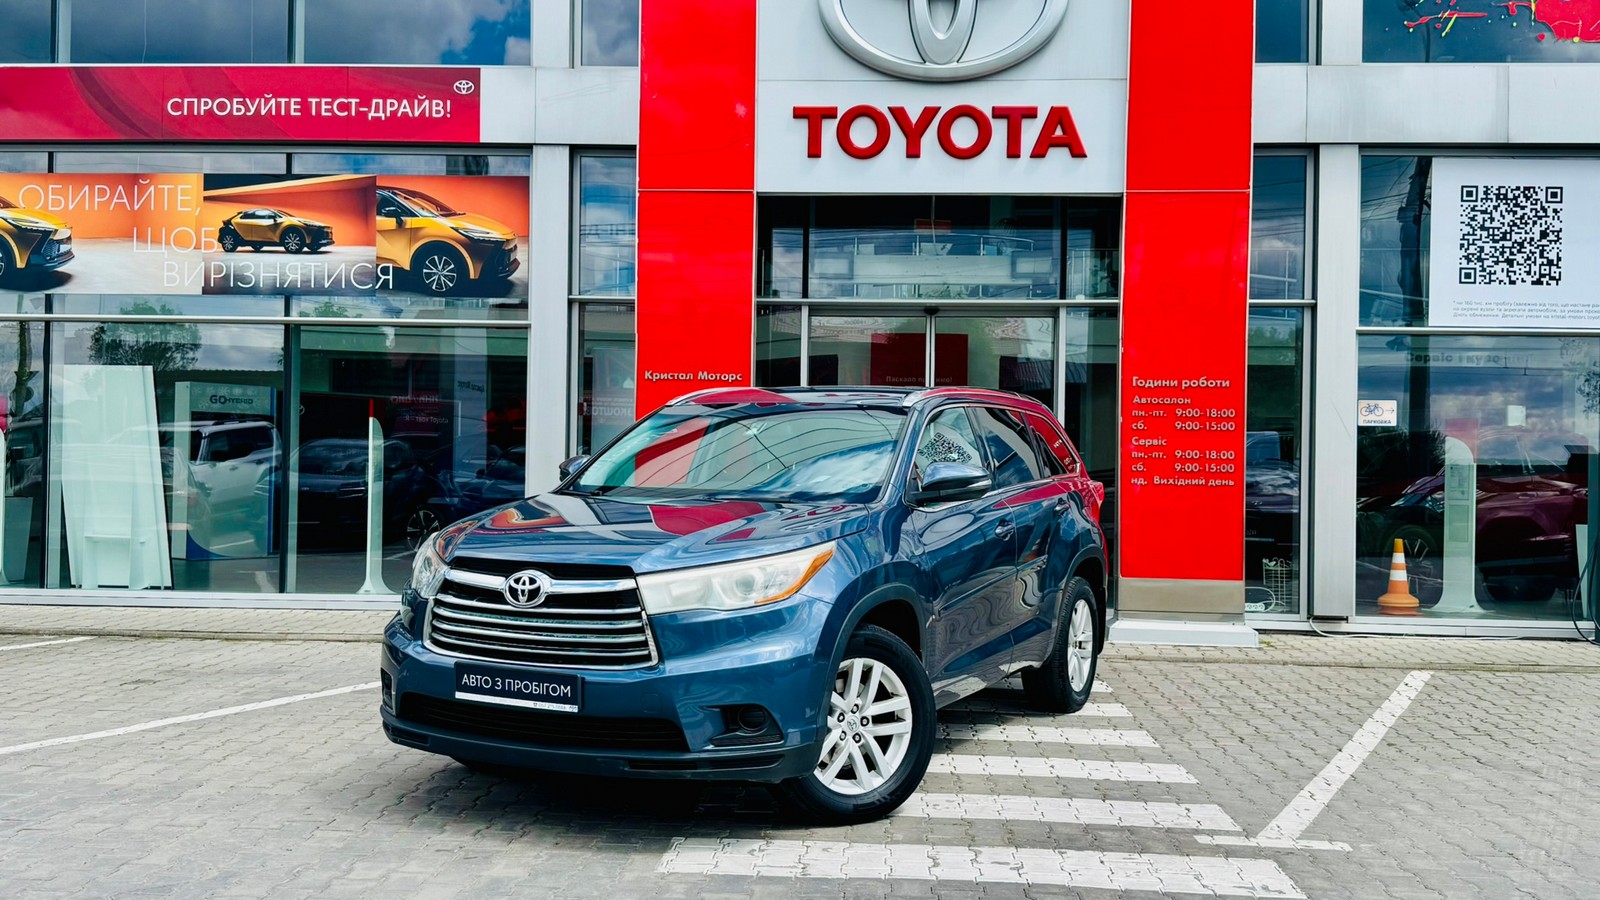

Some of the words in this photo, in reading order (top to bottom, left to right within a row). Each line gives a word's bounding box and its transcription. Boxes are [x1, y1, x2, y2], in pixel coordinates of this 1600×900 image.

[167, 94, 302, 117] СПРОБУЙТЕ
[308, 94, 452, 121] ТЕСТ-ДРАЙВ!
[793, 105, 1086, 160] TOYOTA
[18, 178, 201, 216] ОБИРАЙТЕ,
[133, 226, 218, 258] ЩОБ
[163, 261, 393, 290] ВИРІЗНЯТИСЯ
[644, 369, 694, 384] Кристал
[697, 370, 743, 385] Моторс
[1132, 376, 1178, 388] Години
[1181, 376, 1230, 390] роботи
[1132, 395, 1191, 404] Автосалон
[1131, 409, 1167, 418] пн.-пт.
[1175, 408, 1236, 418] 9:00-18:00
[1131, 420, 1147, 430] сб.
[1174, 421, 1236, 431] 9:00-15:00
[1131, 436, 1167, 448] Сервіс
[1131, 450, 1167, 459] пн.-пт.
[1174, 449, 1236, 460] 9:00-18:00
[1131, 462, 1147, 472] сб.
[1174, 463, 1235, 473] 9:00-15:00
[1131, 477, 1148, 487] нд.
[1153, 475, 1206, 486] Вихідний
[1207, 478, 1235, 488] день
[461, 673, 492, 689] АВТО
[494, 677, 502, 690] З
[505, 678, 571, 698] ПРОБІГОМ
